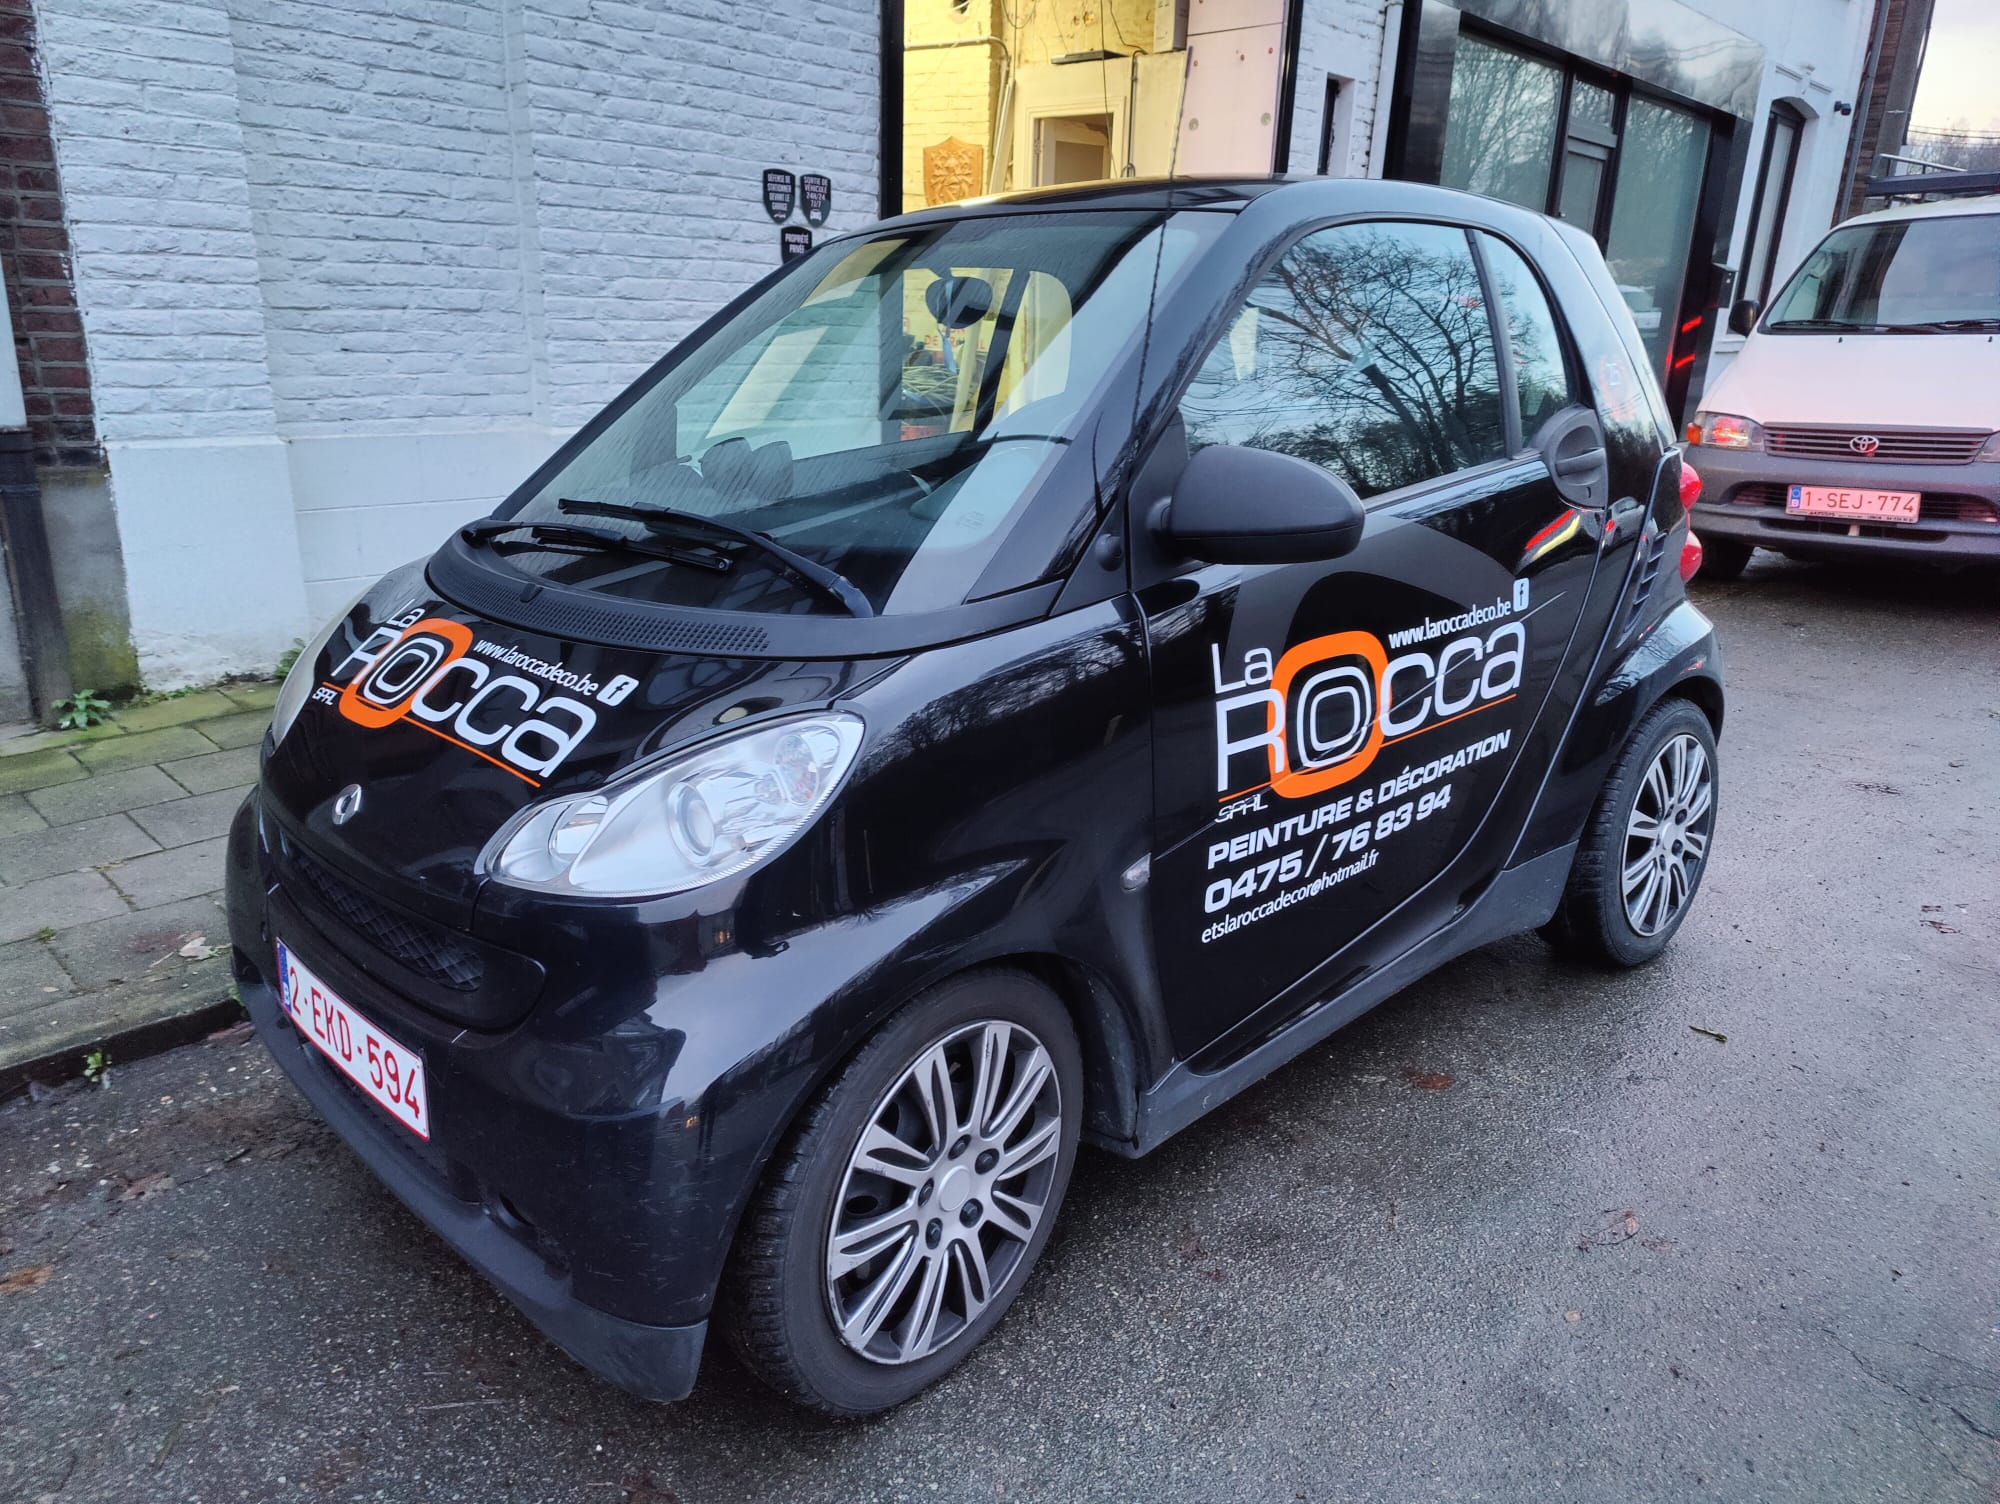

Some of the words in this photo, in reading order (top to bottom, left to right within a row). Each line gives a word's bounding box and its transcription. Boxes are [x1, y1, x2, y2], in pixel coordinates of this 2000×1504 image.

[803, 175, 820, 186] SORTIE
[821, 178, 828, 186] DE
[804, 183, 827, 194] VÉHICULE
[785, 232, 809, 244] PROPRIÉTÉ
[789, 243, 805, 254] PRIVÉE
[1805, 491, 1915, 513] 1-SEJ-774
[387, 598, 426, 628] La
[1388, 596, 1512, 649] www.laroccadeco.be
[473, 639, 599, 696] www.laroccadeco.be
[1212, 643, 1273, 694] La
[1207, 794, 1353, 870] PEINTURE
[1355, 788, 1374, 813] &
[1377, 729, 1512, 804] DÉCORATION
[1204, 849, 1304, 914] 0475
[1331, 825, 1371, 861] 76
[1374, 797, 1413, 841] 83
[1415, 783, 1452, 822] 94
[1201, 848, 1380, 944] etslaroccadecor@hotmail.fr
[290, 966, 420, 1119] 2-EKD-594
